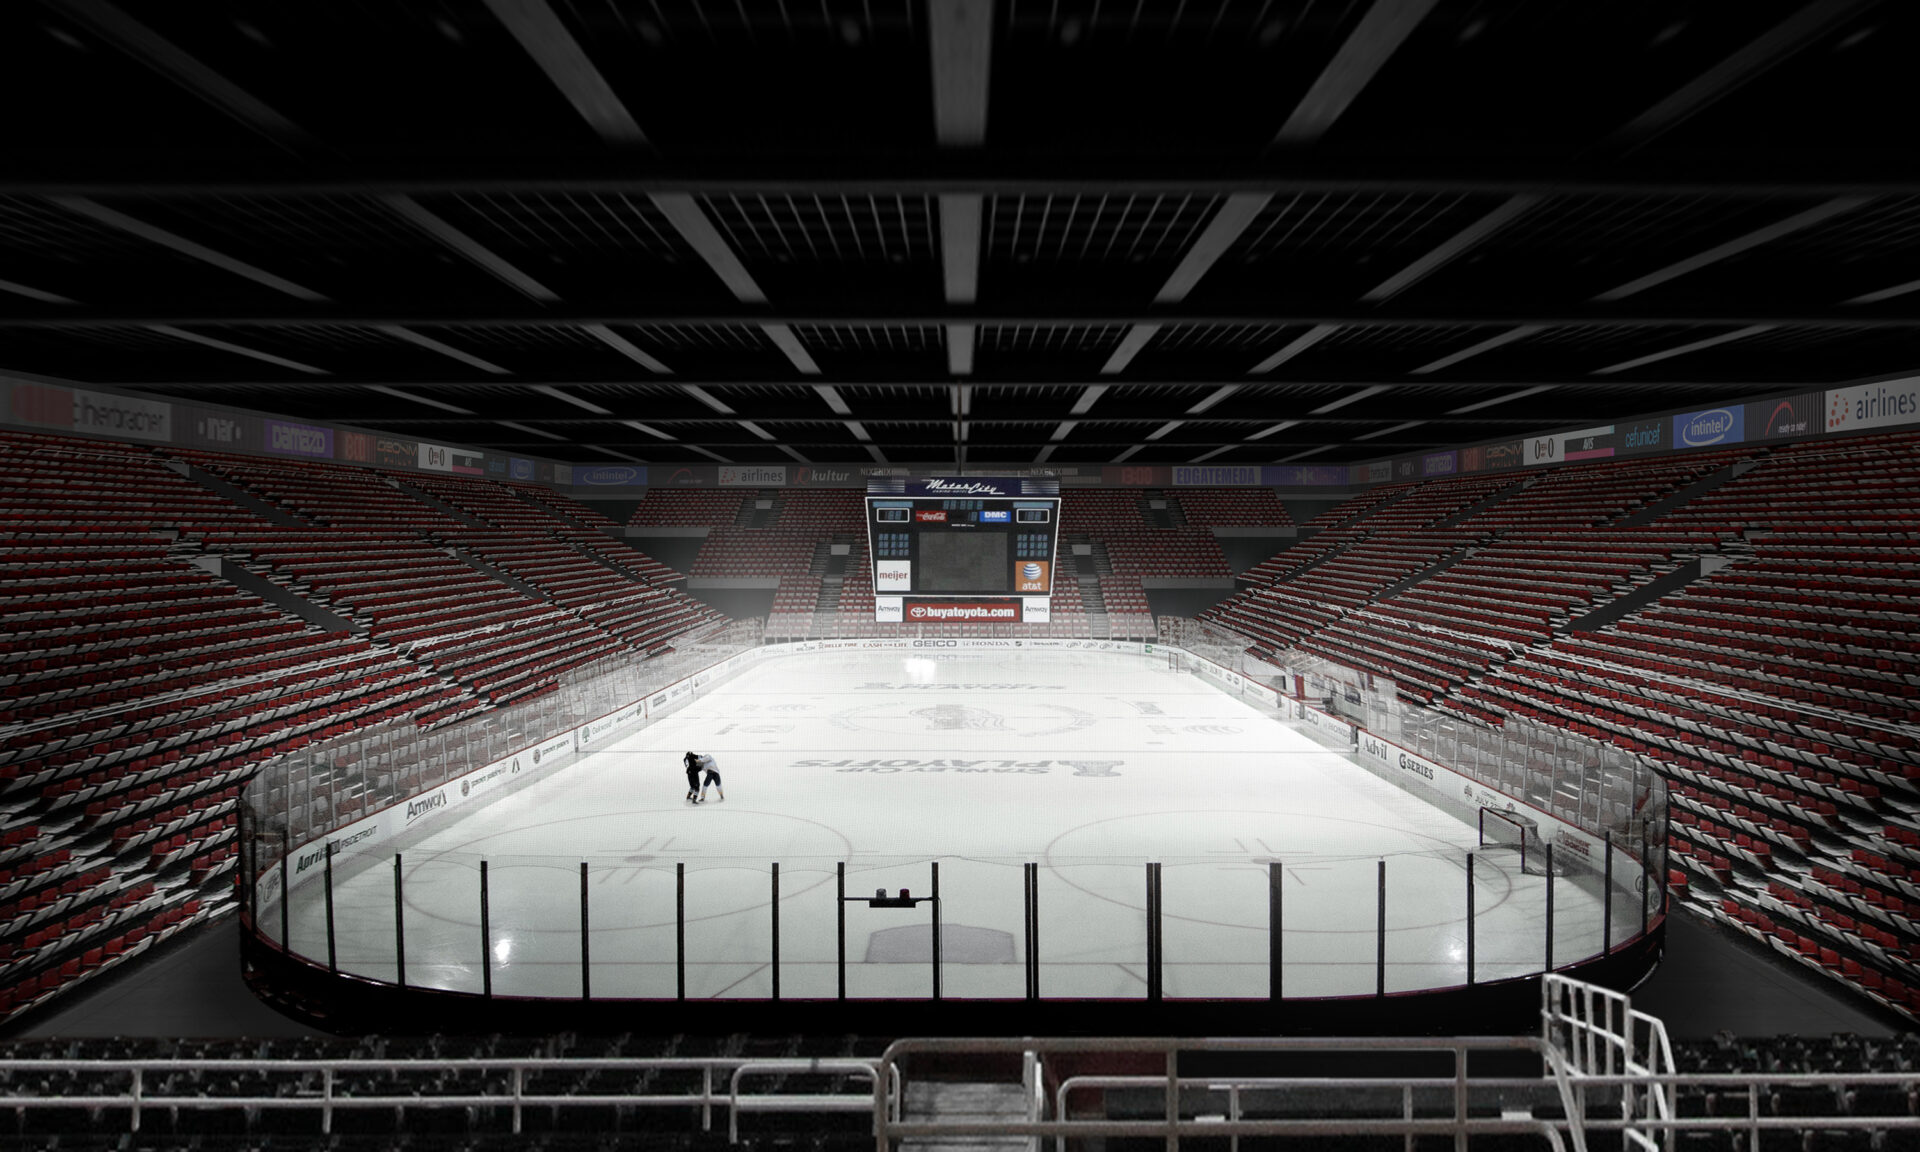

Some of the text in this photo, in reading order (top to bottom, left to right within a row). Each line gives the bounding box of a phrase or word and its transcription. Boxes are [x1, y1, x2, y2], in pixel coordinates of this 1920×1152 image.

[1856, 387, 1917, 420] airlines
[741, 468, 783, 482] airlines
[811, 469, 849, 482] kultur
[983, 511, 1008, 519] DMC
[879, 571, 908, 581] meijer
[877, 605, 901, 613] Amway
[926, 606, 1015, 620] buyatoyota.com
[1023, 605, 1048, 613] Amway
[912, 640, 957, 648] GEICO
[1363, 736, 1387, 761] Advil
[789, 759, 1054, 768] PLAYOFFS
[1406, 758, 1434, 780] SERIES
